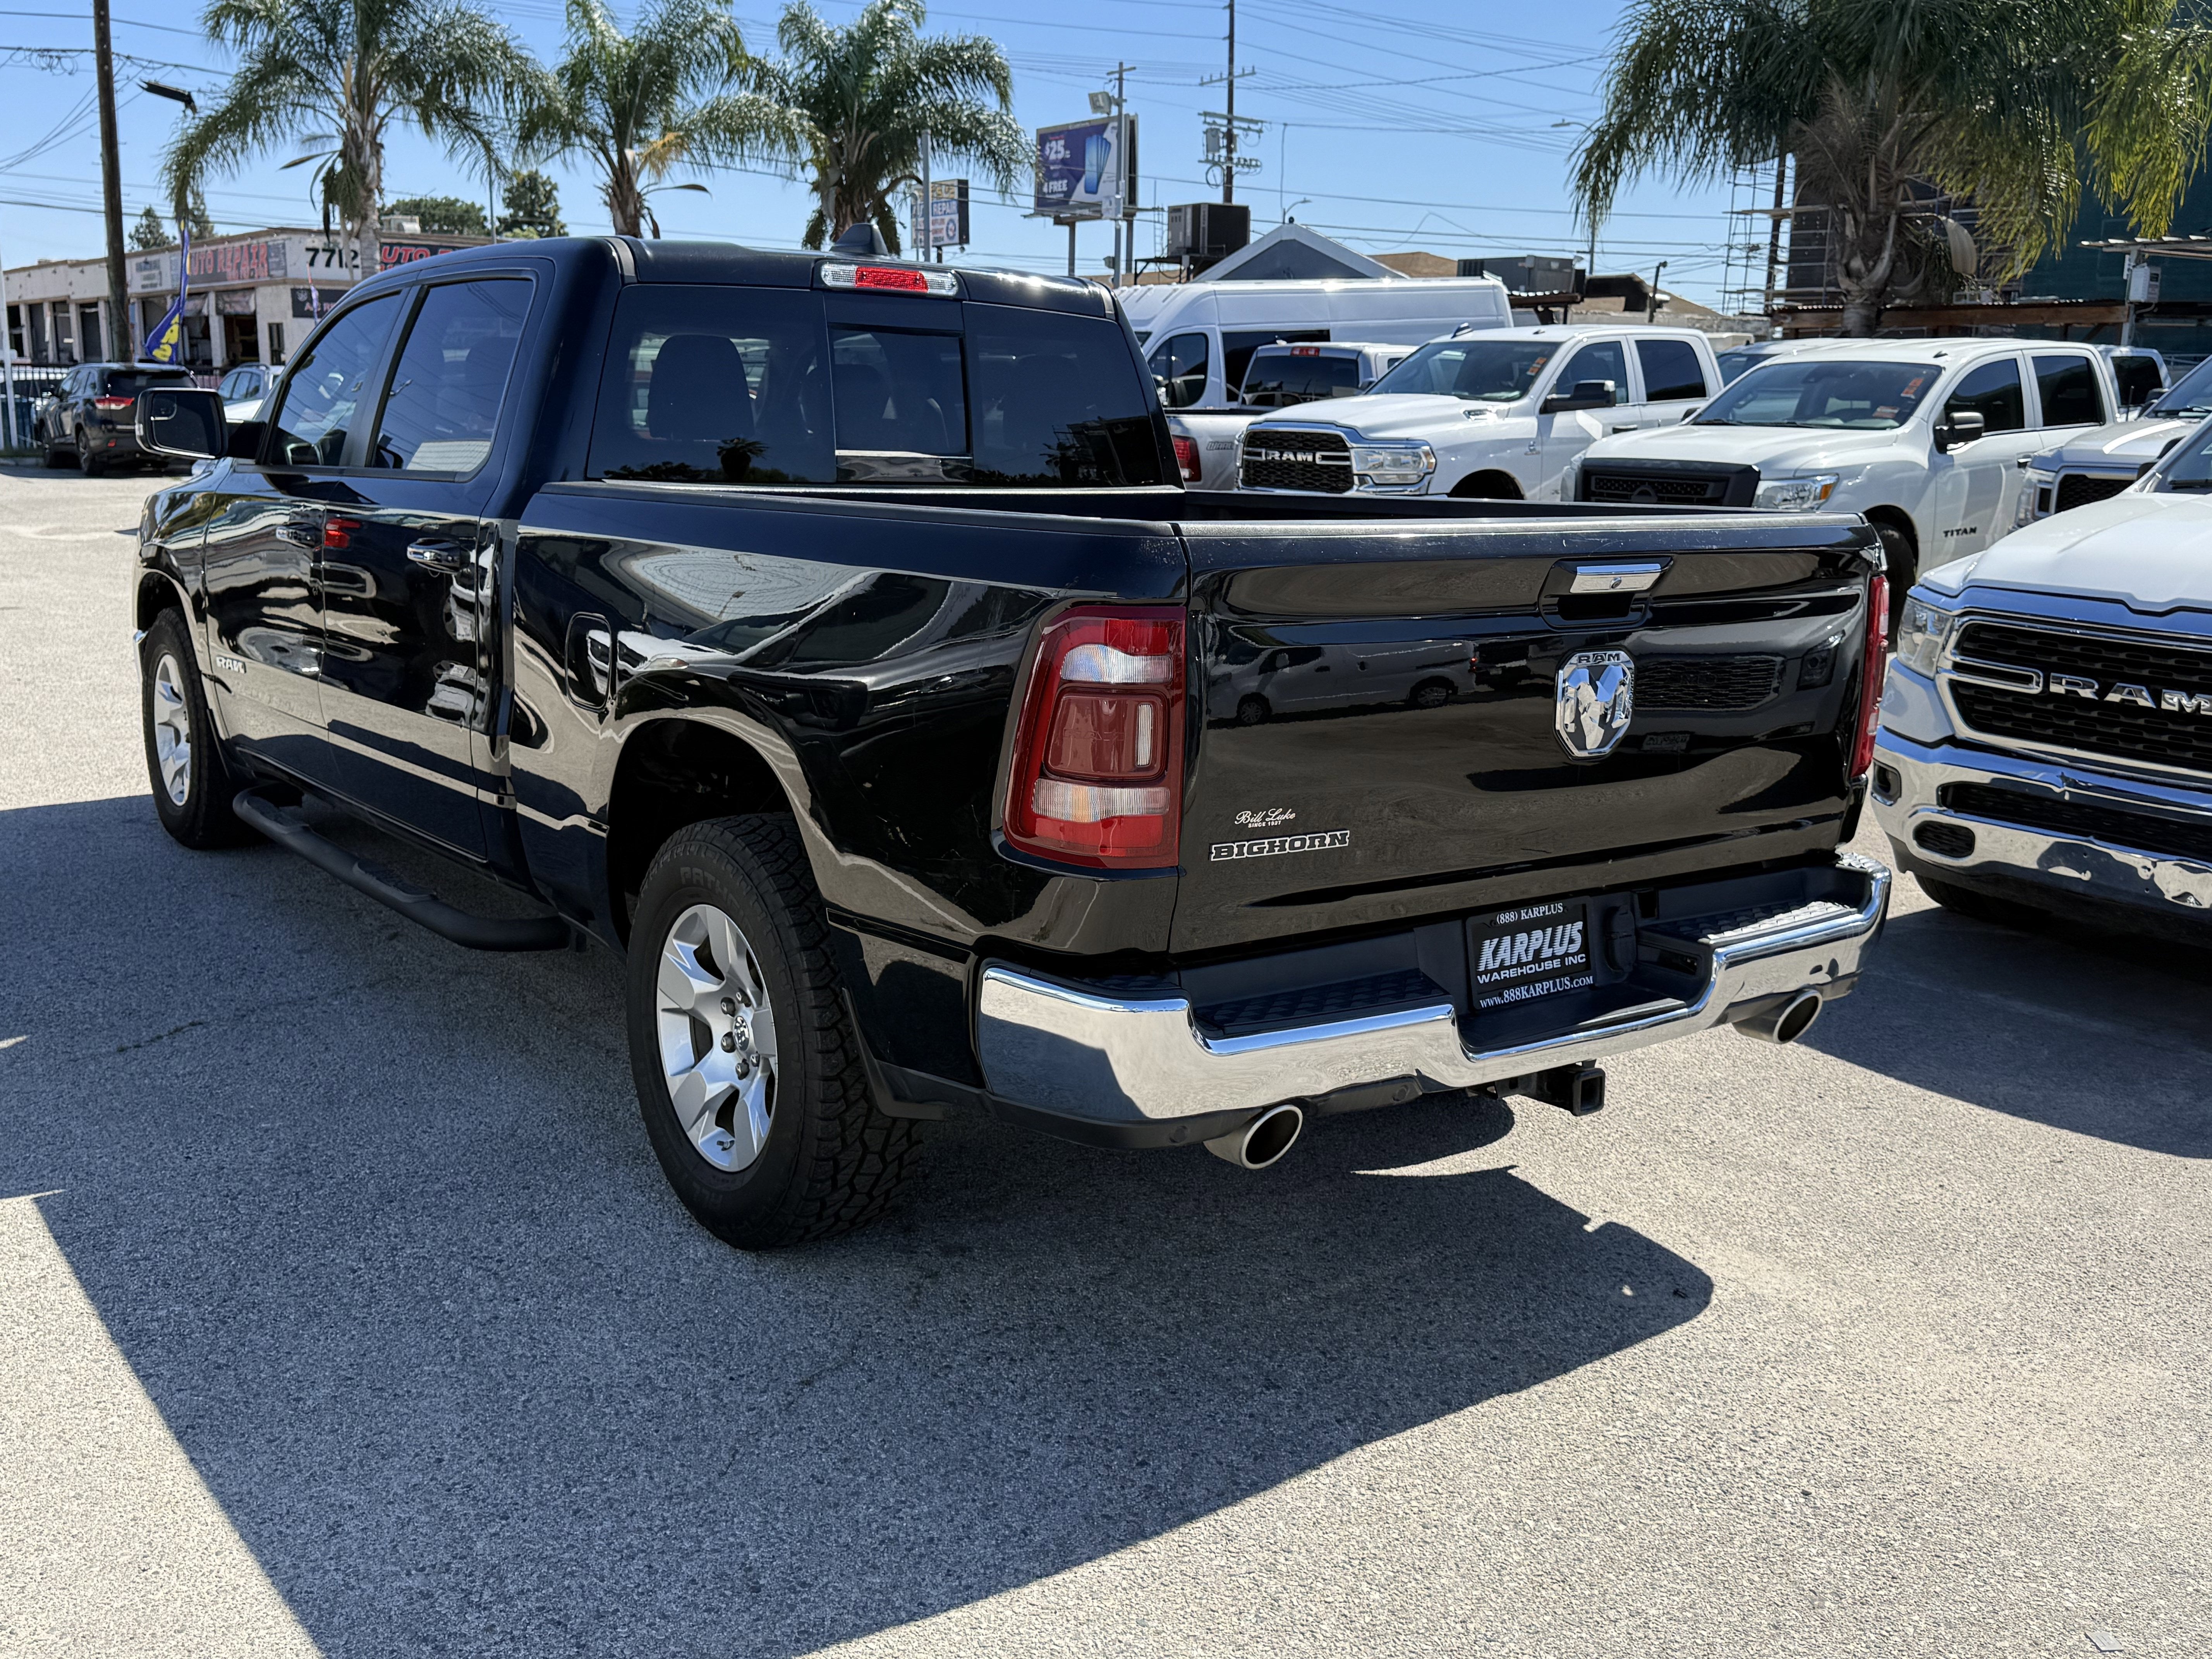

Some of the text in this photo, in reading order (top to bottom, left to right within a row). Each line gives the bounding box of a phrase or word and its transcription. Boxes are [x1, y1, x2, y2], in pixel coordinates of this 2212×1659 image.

[1049, 180, 1068, 193] FREE
[191, 249, 214, 276] UTO
[217, 243, 269, 273] REPAIR
[306, 247, 359, 268] 7712
[381, 246, 430, 263] UTO
[1267, 450, 1313, 462] RAM
[1943, 527, 1977, 538] TITAN
[216, 656, 246, 674] RAM
[1578, 653, 1621, 664] RAM
[2050, 673, 2212, 716] RAM
[1235, 808, 1296, 824] Bill Luke
[1211, 830, 1350, 861] BIGHORN
[1496, 903, 1563, 924] (888) KARPLUS
[1477, 921, 1583, 971] KARPLUS
[1477, 954, 1586, 984] WAREHOUSE INC
